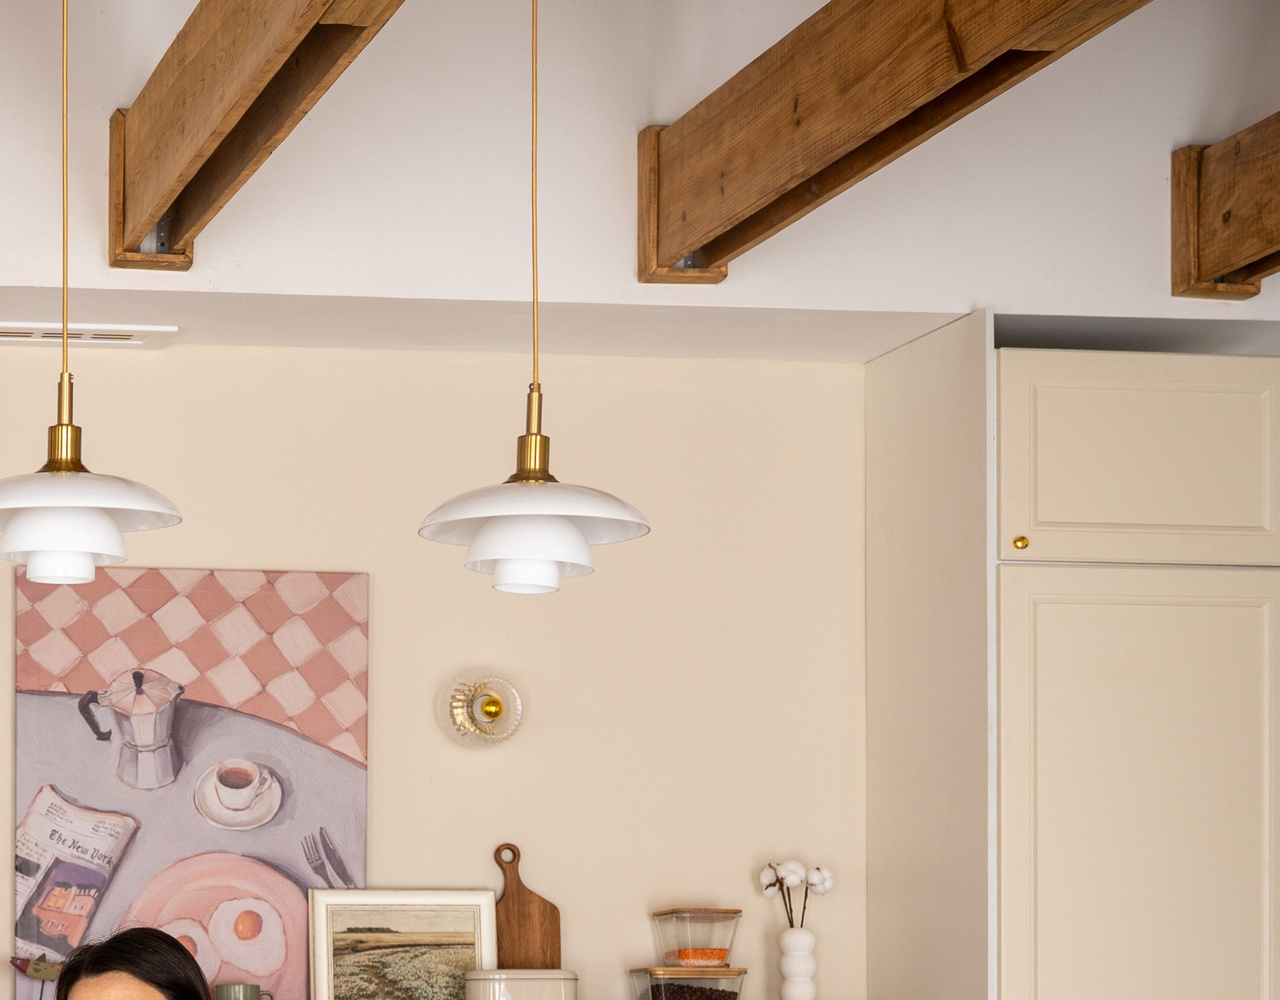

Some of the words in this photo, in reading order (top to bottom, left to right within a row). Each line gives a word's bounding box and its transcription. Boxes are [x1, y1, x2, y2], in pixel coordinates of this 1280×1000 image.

[49, 829, 67, 845] The
[68, 838, 89, 855] New
[90, 847, 113, 868] York
